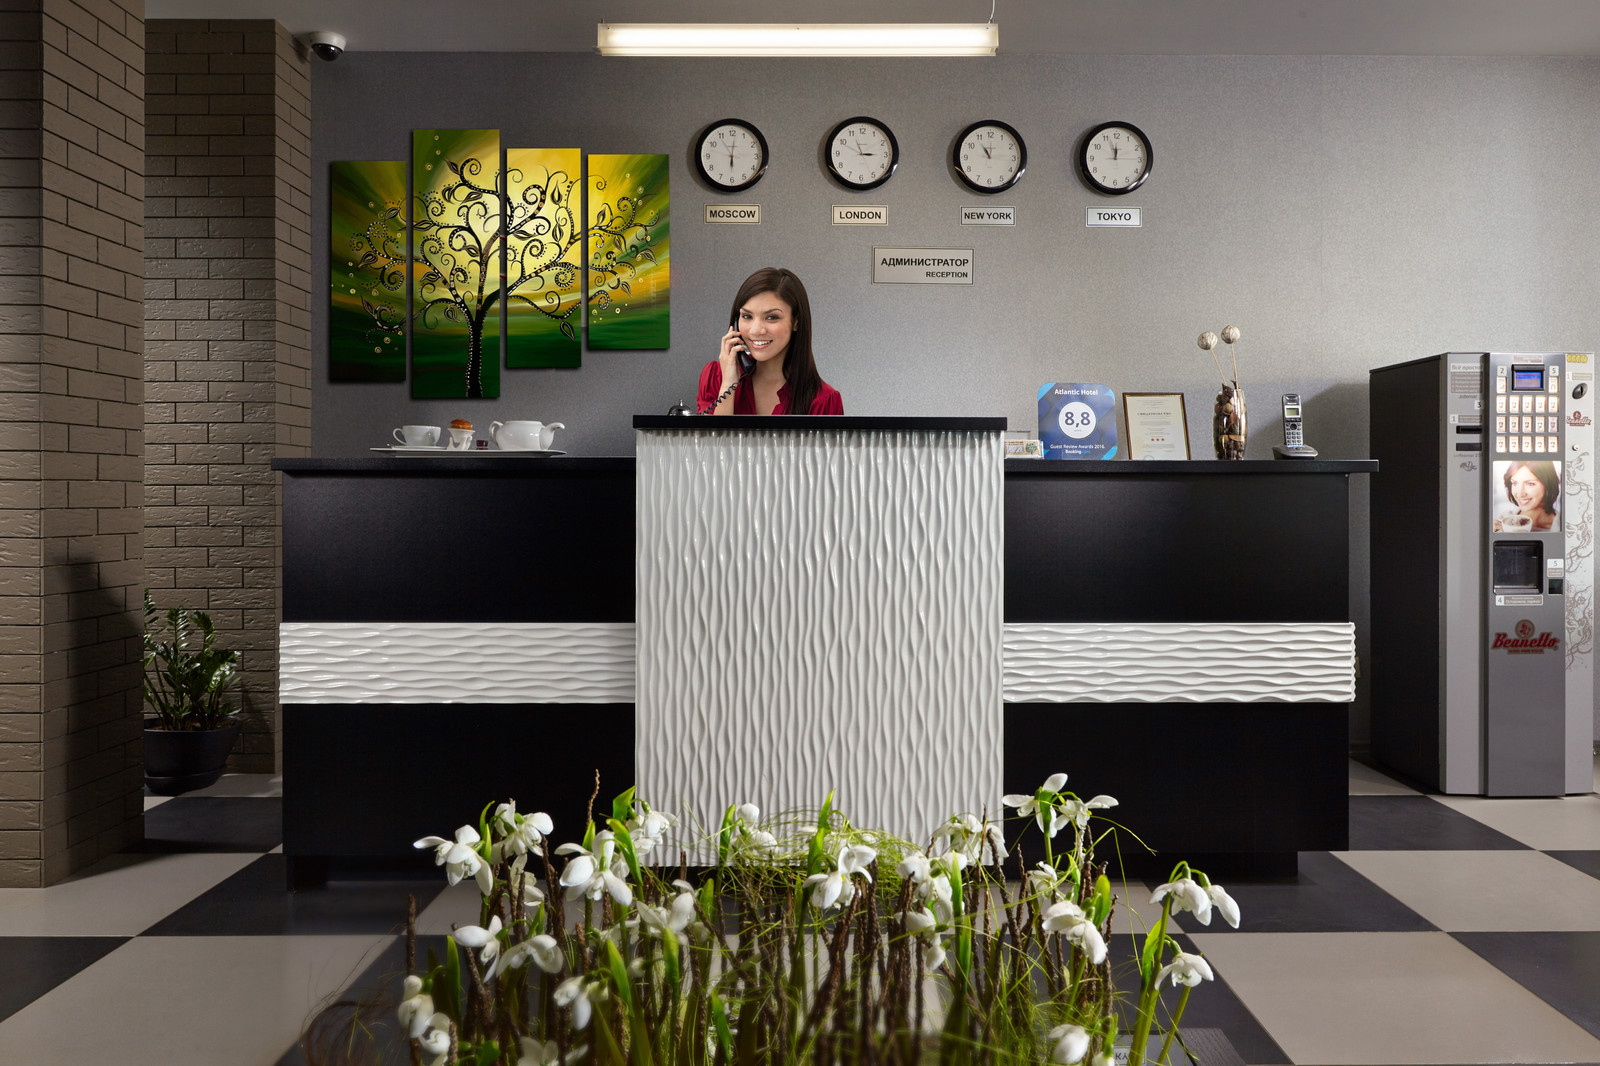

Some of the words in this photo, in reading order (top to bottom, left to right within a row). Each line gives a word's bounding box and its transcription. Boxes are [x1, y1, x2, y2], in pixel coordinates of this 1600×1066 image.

[710, 210, 756, 218] MOSCOW
[840, 211, 882, 219] LONDON
[964, 212, 985, 220] NEW
[987, 212, 1012, 220] YORK
[1097, 213, 1132, 221] TOKYO
[881, 258, 969, 267] АДМИНИСТРАТОР
[1065, 412, 1090, 428] 8,8
[1493, 632, 1558, 648] Beanello
